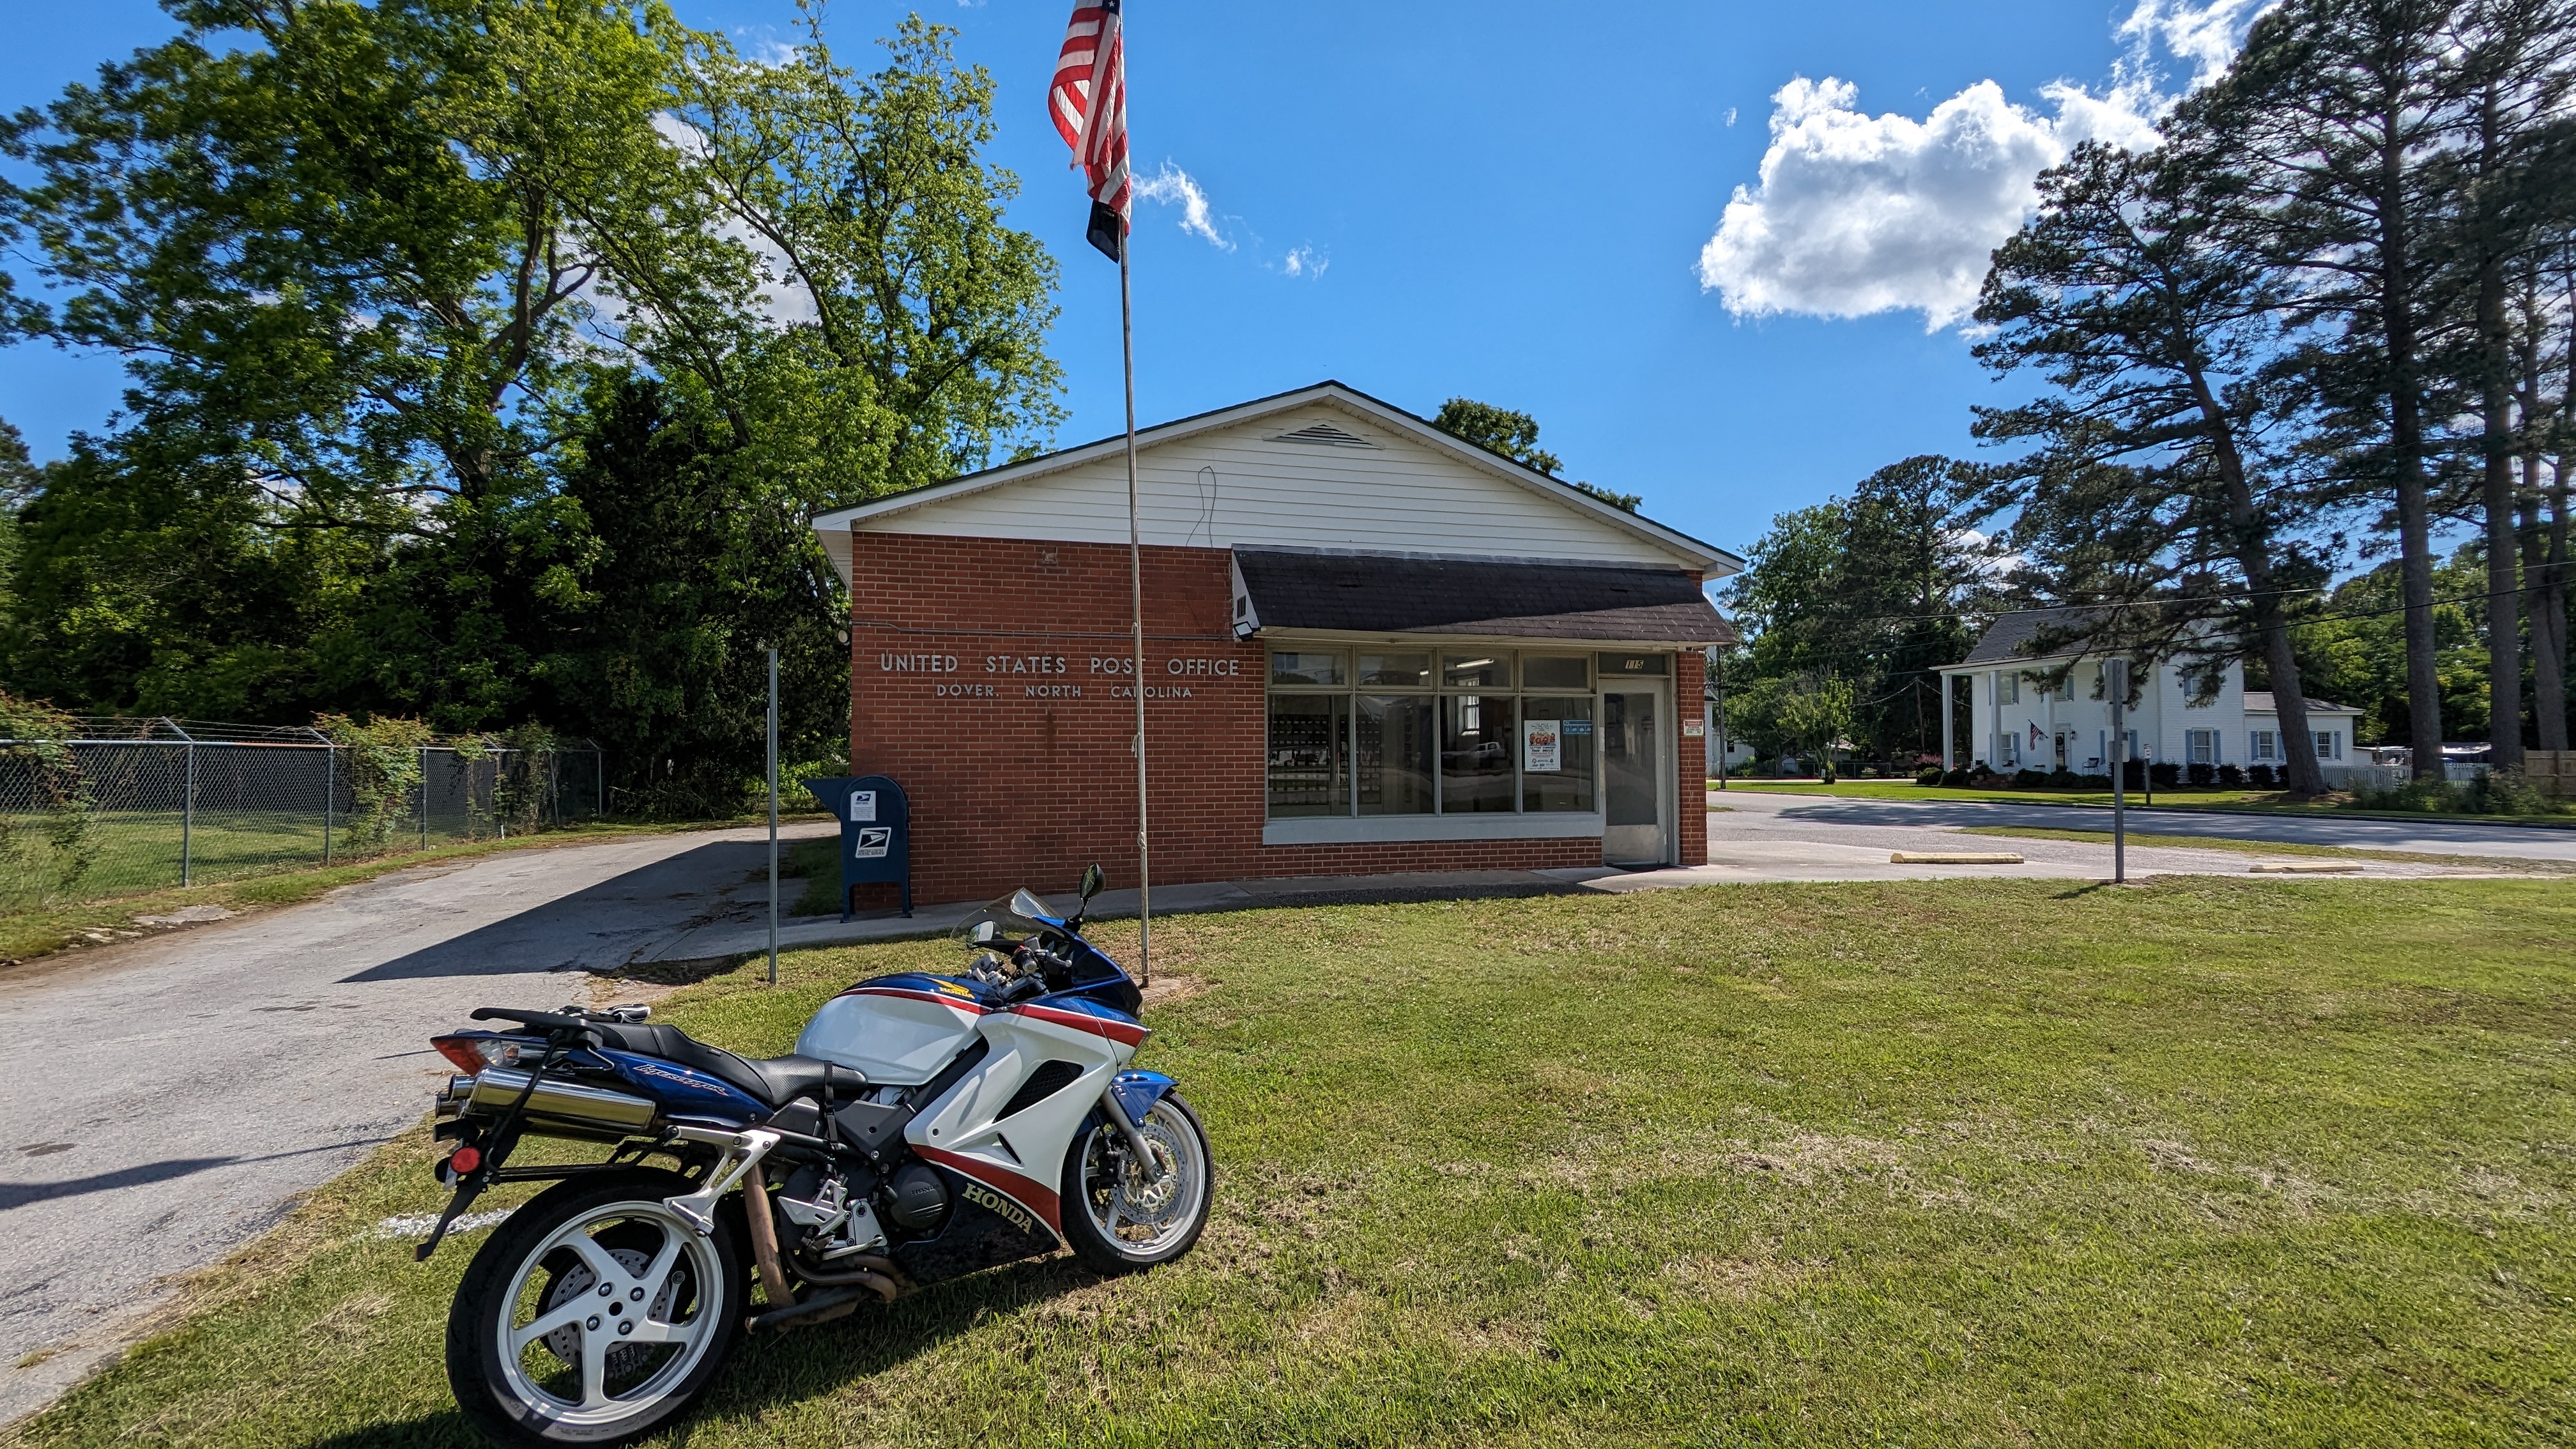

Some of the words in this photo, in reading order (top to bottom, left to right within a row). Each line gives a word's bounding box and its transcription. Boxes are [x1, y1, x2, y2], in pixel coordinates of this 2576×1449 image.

[880, 653, 958, 672] UNITED
[985, 656, 1066, 673] STATES
[1091, 657, 1146, 674] POS
[1167, 658, 1239, 676] OFFICE
[1627, 660, 1643, 668] 115
[1025, 685, 1081, 697] NORTH
[962, 1183, 1033, 1234] HONDA
